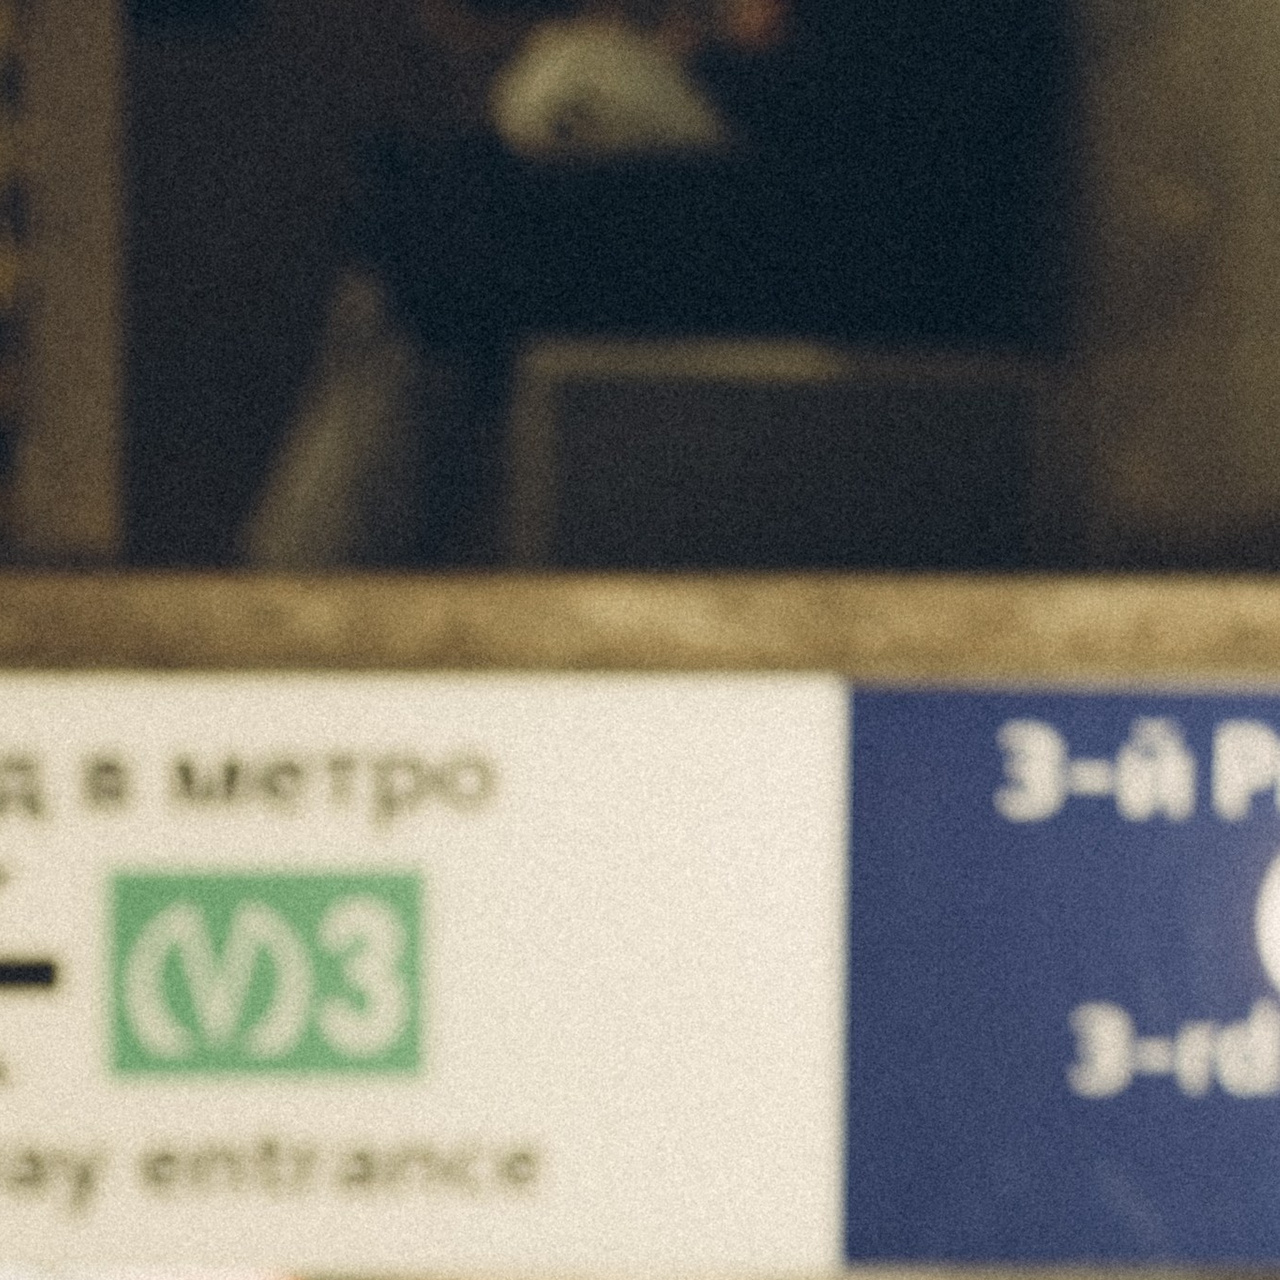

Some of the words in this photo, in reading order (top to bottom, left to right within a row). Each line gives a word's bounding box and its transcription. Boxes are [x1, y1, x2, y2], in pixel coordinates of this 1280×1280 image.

[80, 752, 130, 809] в
[168, 752, 492, 822] метро
[996, 716, 1197, 821] 3-й
[1211, 719, 1280, 820] Р
[1069, 998, 1280, 1098] 3-rd
[133, 1134, 540, 1199] entrance
